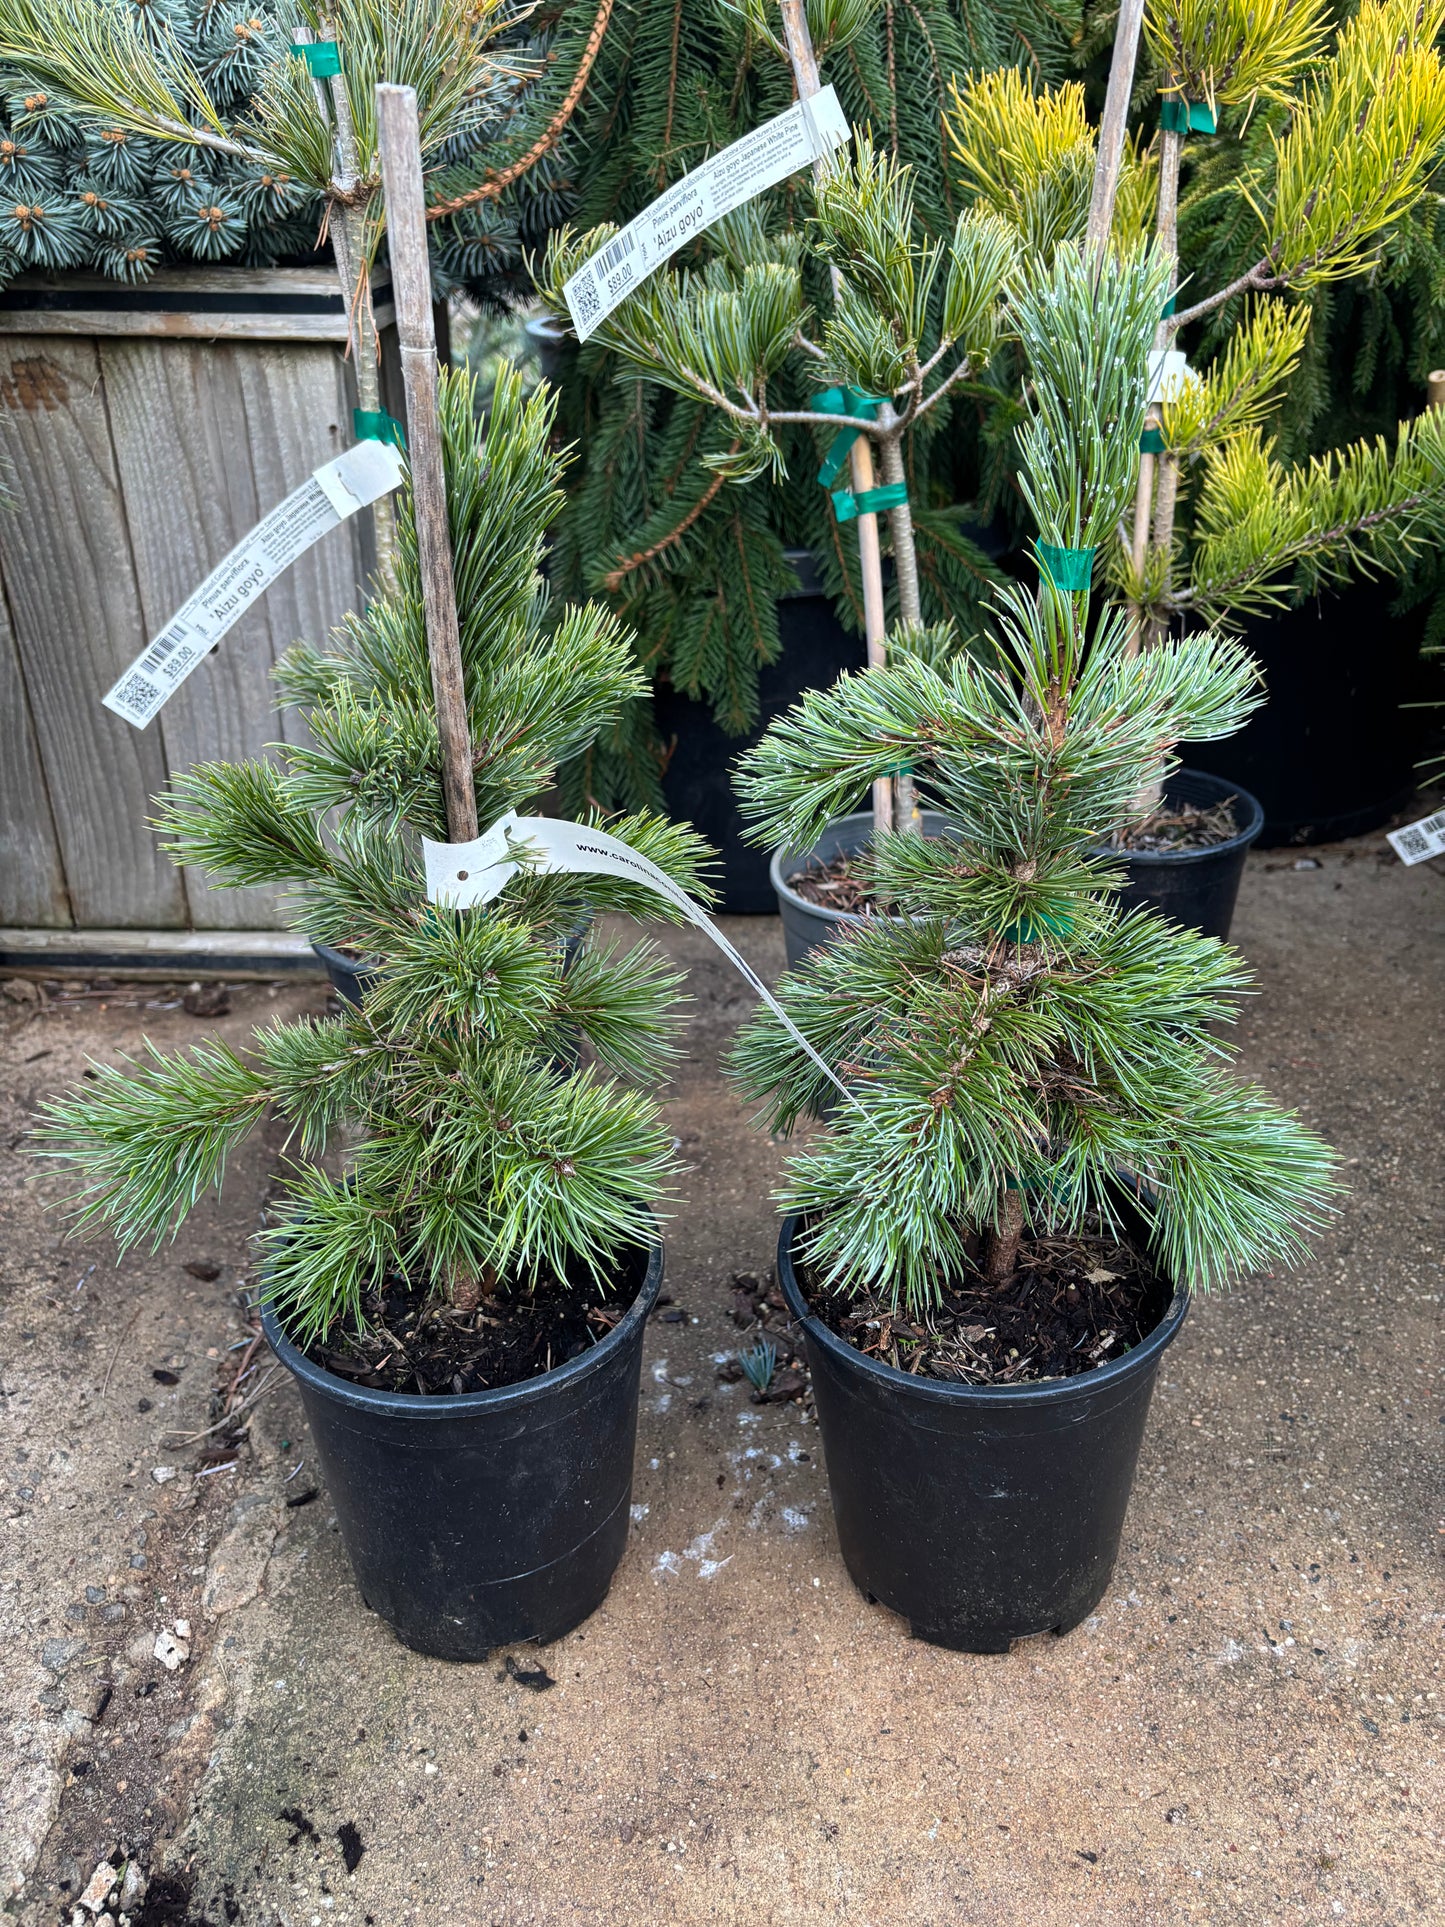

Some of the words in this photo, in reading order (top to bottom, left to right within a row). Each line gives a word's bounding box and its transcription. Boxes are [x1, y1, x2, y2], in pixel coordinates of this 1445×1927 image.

[767, 131, 784, 144] White
[784, 123, 797, 135] Pine
[651, 211, 668, 228] Pinus
[669, 189, 697, 217] parviflora
[606, 262, 633, 293] $89.00
[201, 588, 222, 608] Pinus
[162, 645, 193, 677] $89.00
